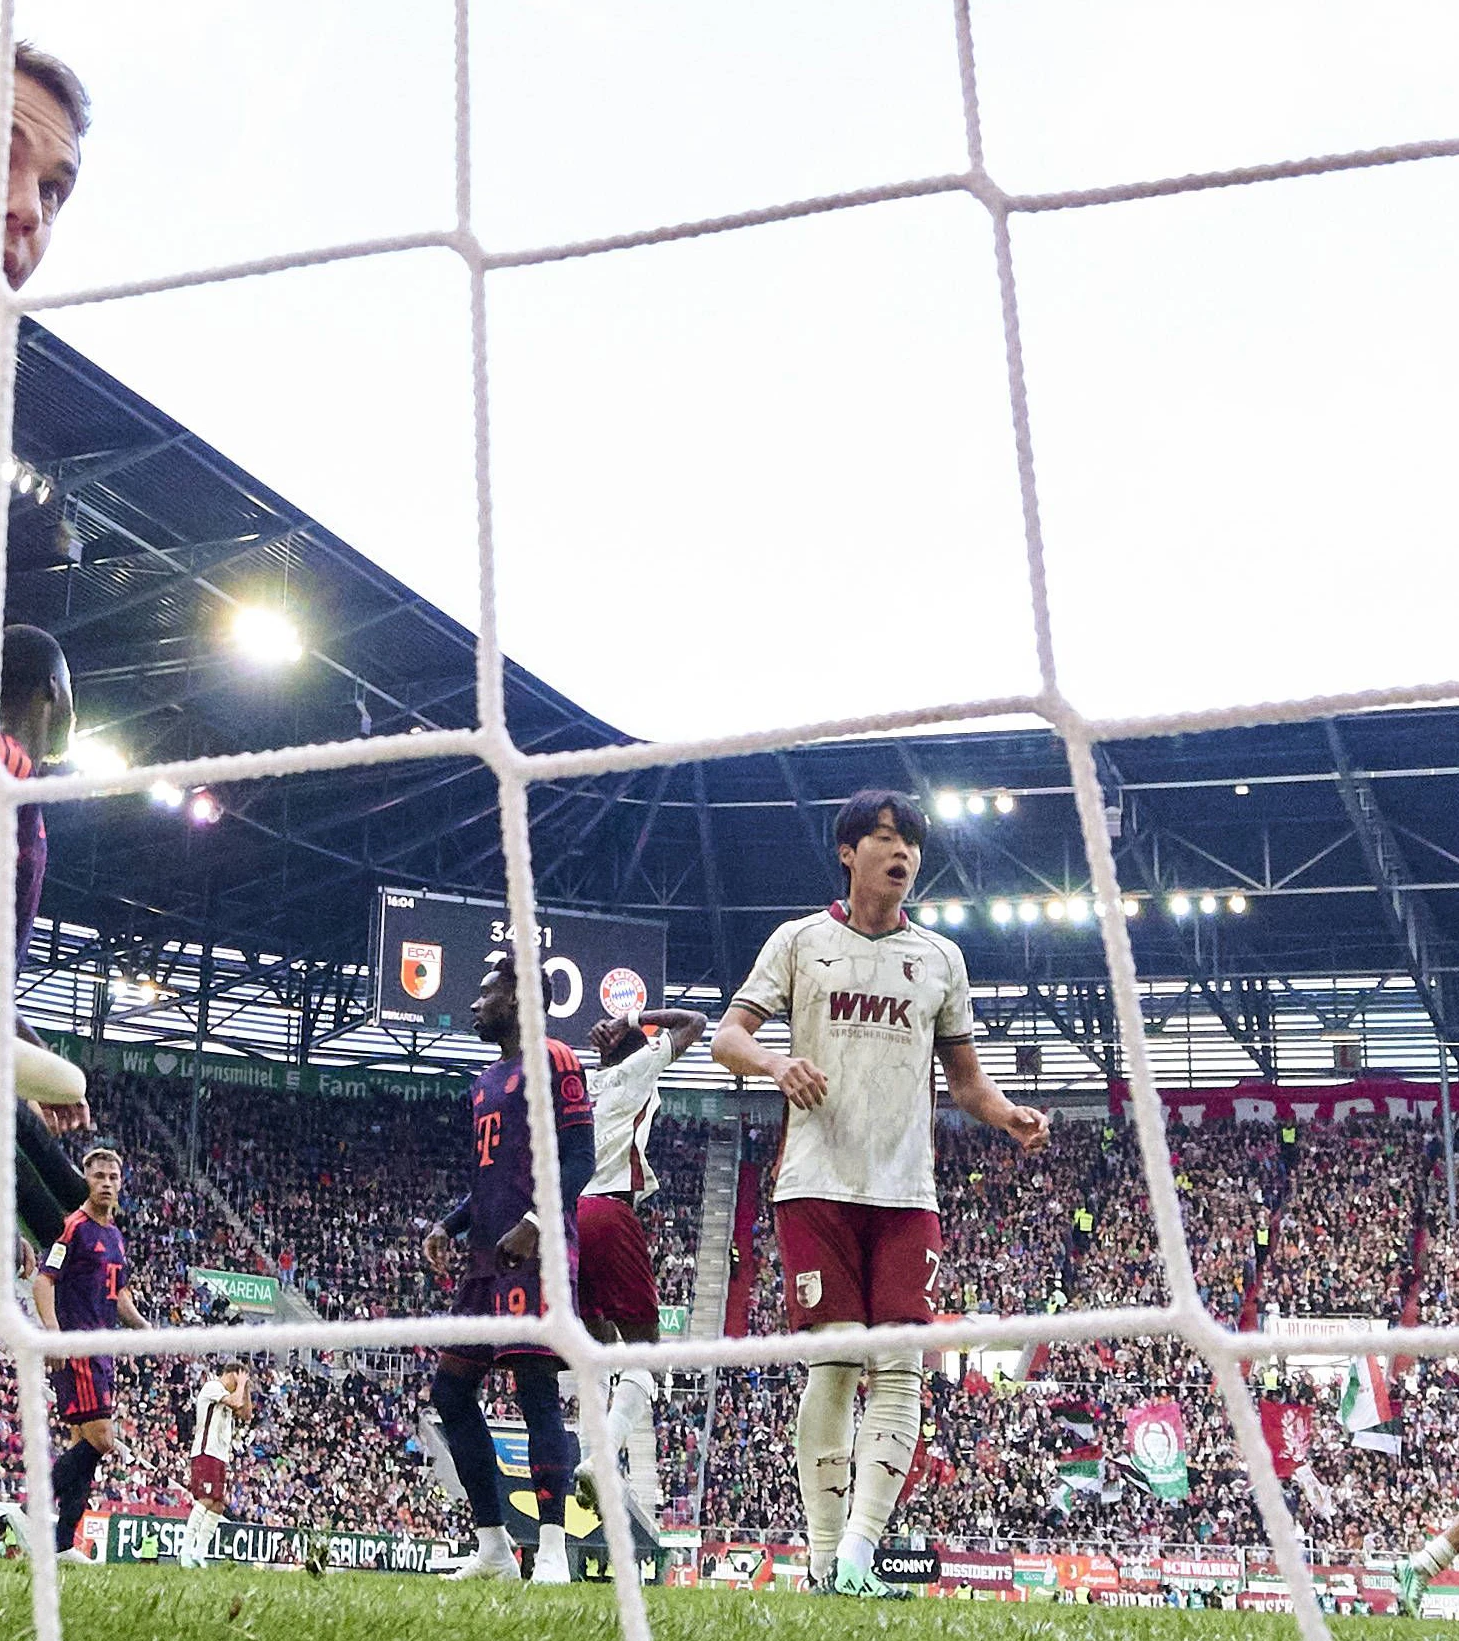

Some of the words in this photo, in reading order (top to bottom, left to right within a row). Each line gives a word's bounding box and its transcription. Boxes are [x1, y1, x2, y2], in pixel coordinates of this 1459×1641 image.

[386, 895, 415, 909] 16:04
[830, 991, 912, 1029] WWK
[122, 1050, 150, 1074] Wir
[925, 1248, 940, 1292] 7
[227, 1280, 273, 1302] ARENA
[881, 1558, 935, 1574] CONNY
[941, 1562, 1013, 1581] DISSIDENTS
